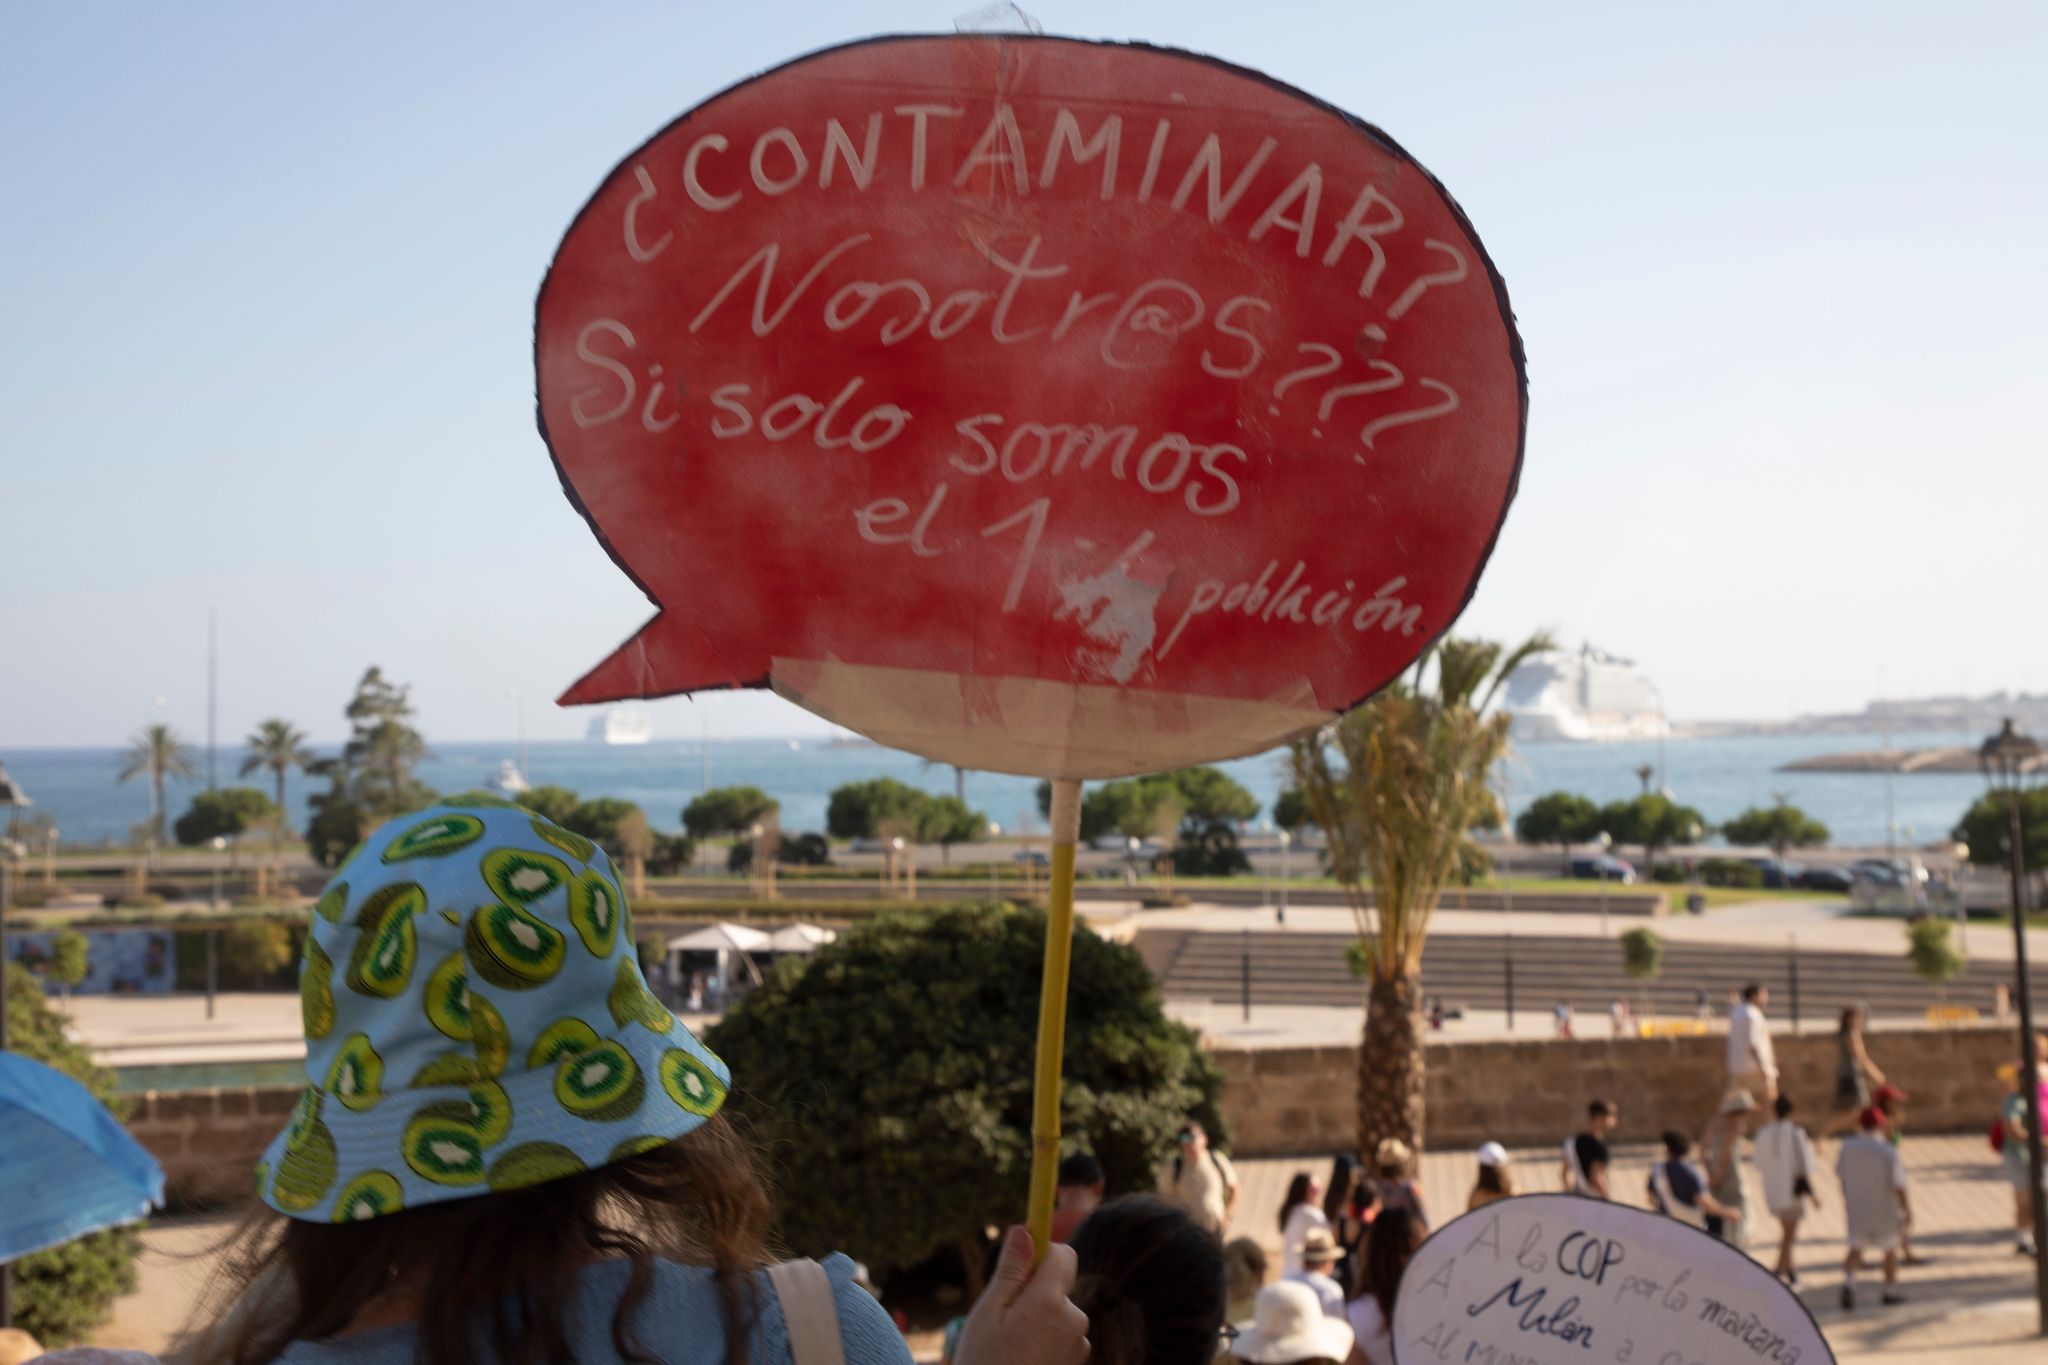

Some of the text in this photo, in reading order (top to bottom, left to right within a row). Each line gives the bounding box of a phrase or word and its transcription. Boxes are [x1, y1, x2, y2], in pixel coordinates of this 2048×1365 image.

[623, 103, 1468, 343] ¿CONTAMINAR?
[570, 318, 1248, 517] Si solo somos
[854, 482, 947, 558] el
[1416, 1256, 1457, 1298] A
[1464, 1212, 1502, 1260] A
[1516, 1221, 1549, 1274] la
[1557, 1230, 1626, 1287] COP
[1614, 1274, 1664, 1304] por
[1661, 1266, 1694, 1313] la
